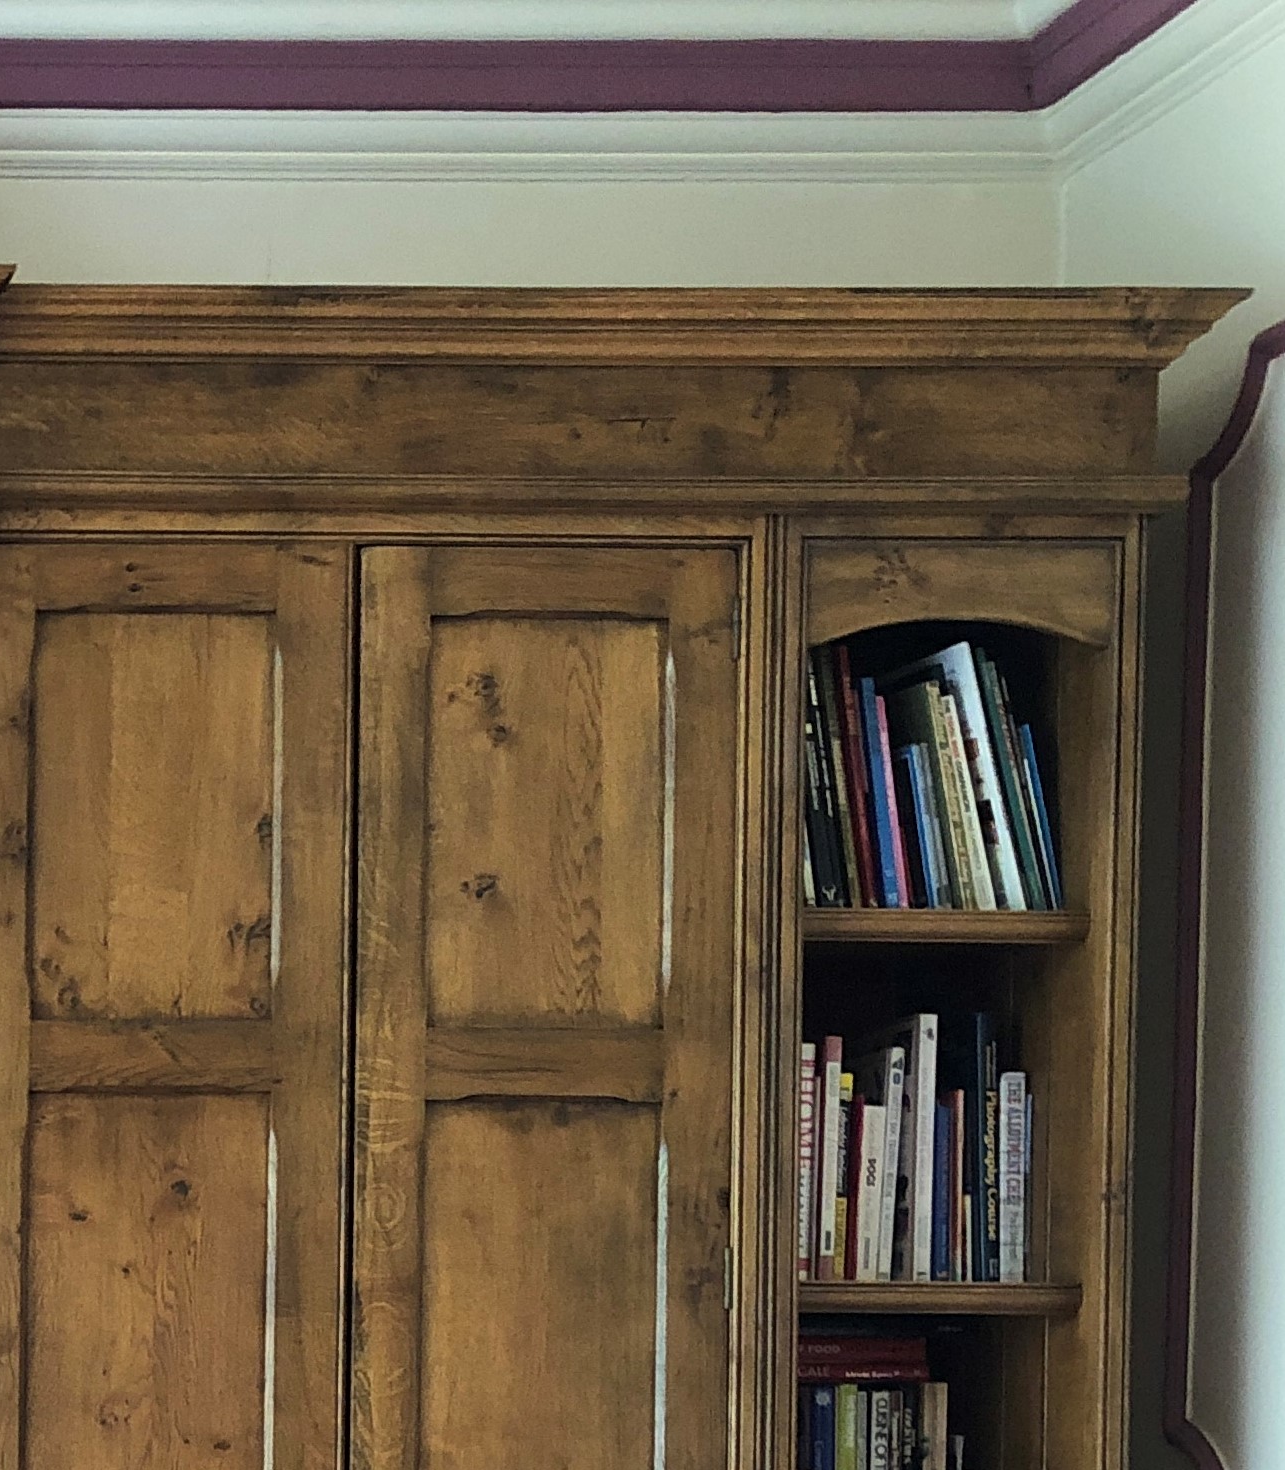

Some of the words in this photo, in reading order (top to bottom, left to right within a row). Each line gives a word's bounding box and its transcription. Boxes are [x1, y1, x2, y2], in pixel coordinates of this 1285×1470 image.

[1007, 1081, 1021, 1103] THE
[983, 1090, 998, 1184] Photography
[1006, 1106, 1021, 1176] ALLOTMENT
[866, 1157, 877, 1187] DOGS
[986, 1187, 998, 1241] Course
[874, 1396, 889, 1443] CUISINE
[874, 1445, 888, 1462] OF
